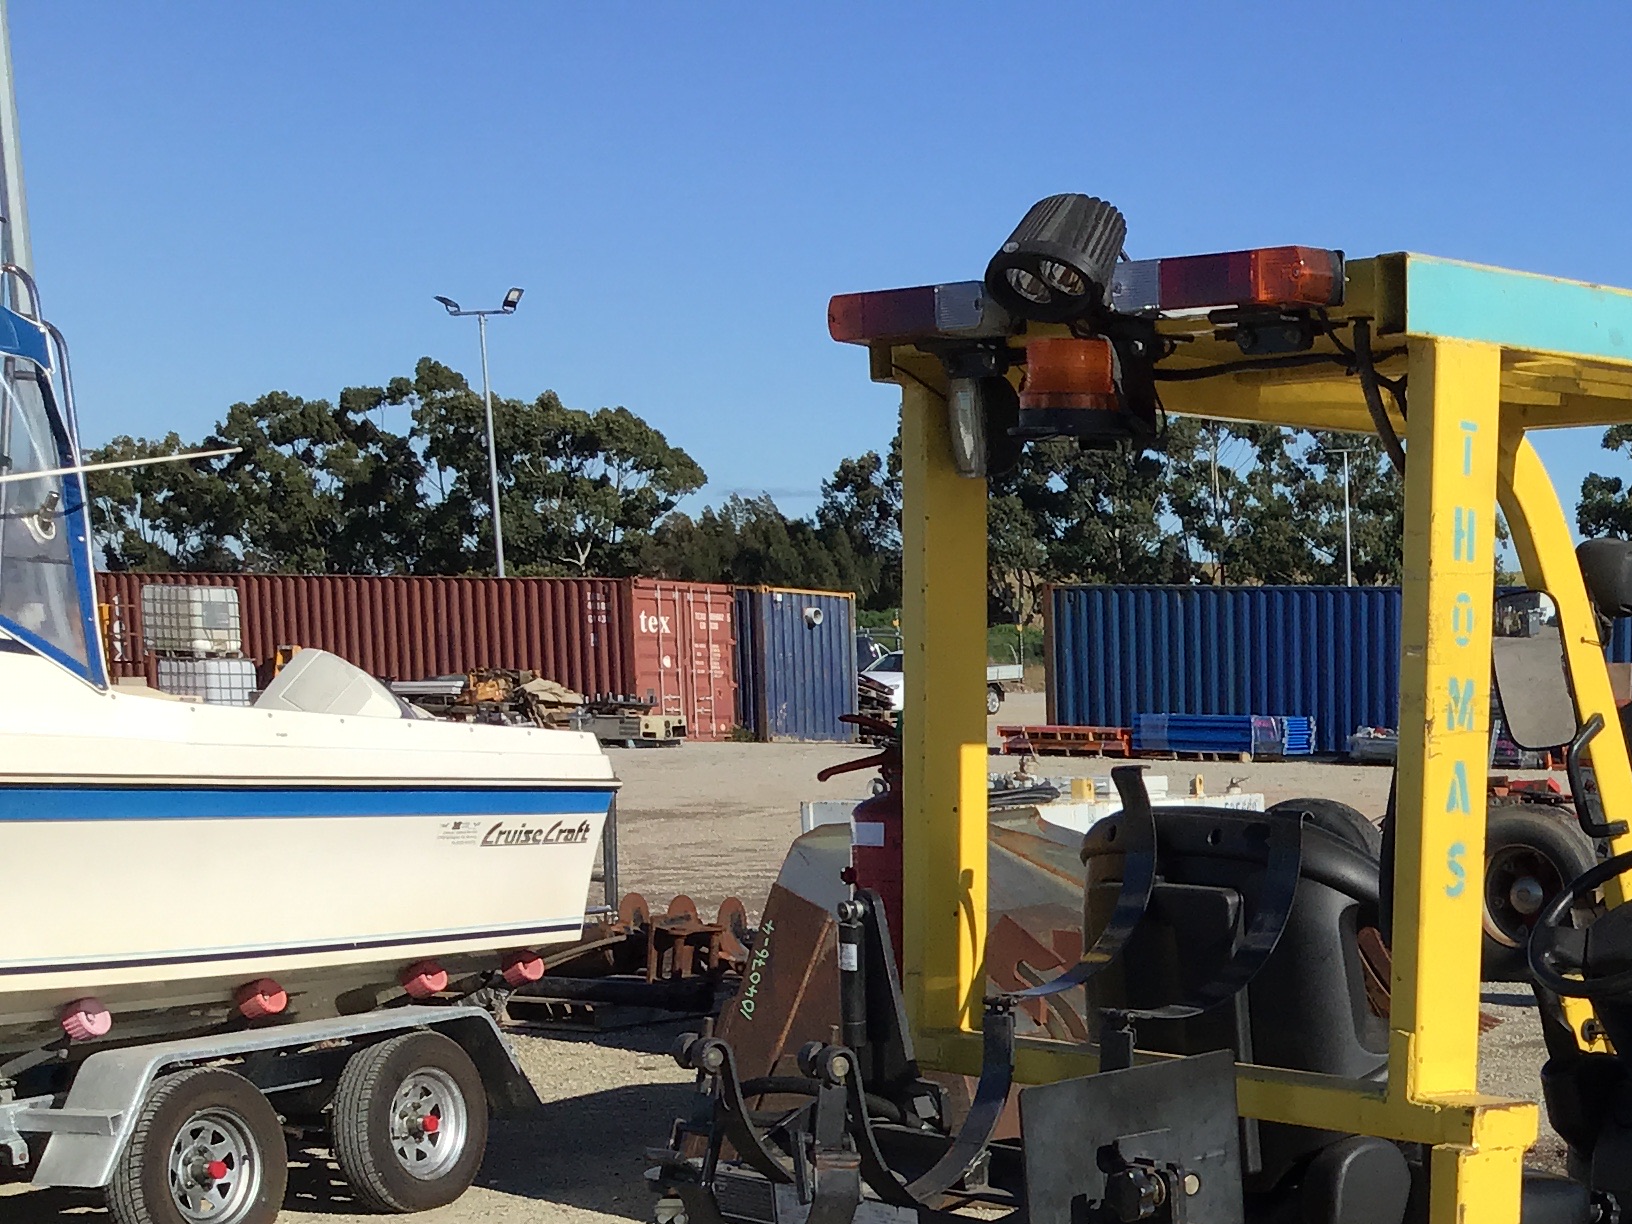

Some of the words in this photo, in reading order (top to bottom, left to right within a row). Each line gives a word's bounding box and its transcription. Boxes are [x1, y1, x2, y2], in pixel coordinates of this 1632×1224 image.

[639, 610, 671, 634] tex
[1444, 420, 1478, 898] THOMAS
[739, 919, 775, 1021] 104076-4
